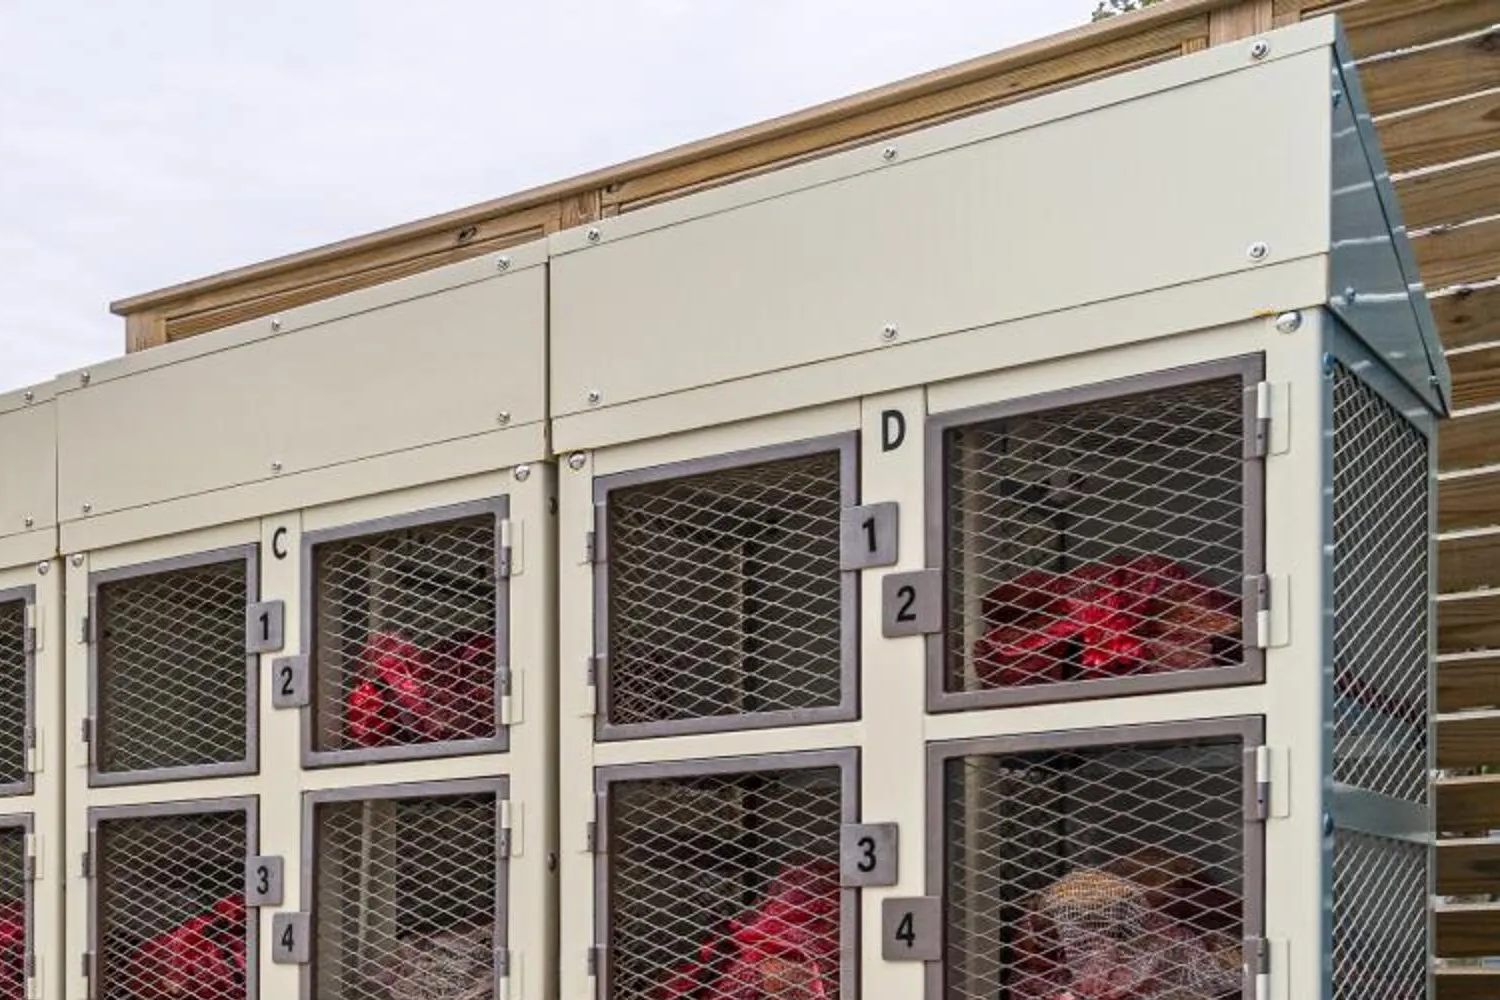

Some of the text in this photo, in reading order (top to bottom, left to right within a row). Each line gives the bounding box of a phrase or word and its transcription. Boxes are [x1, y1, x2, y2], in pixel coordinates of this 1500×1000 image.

[881, 410, 906, 452] D
[273, 527, 287, 559] C
[862, 518, 877, 553] 1
[896, 585, 916, 622] 2
[260, 612, 269, 641] 1
[281, 666, 294, 695] 2
[857, 837, 876, 872] 3
[257, 865, 269, 894] 3
[281, 924, 294, 952] 4
[895, 912, 915, 948] 4
